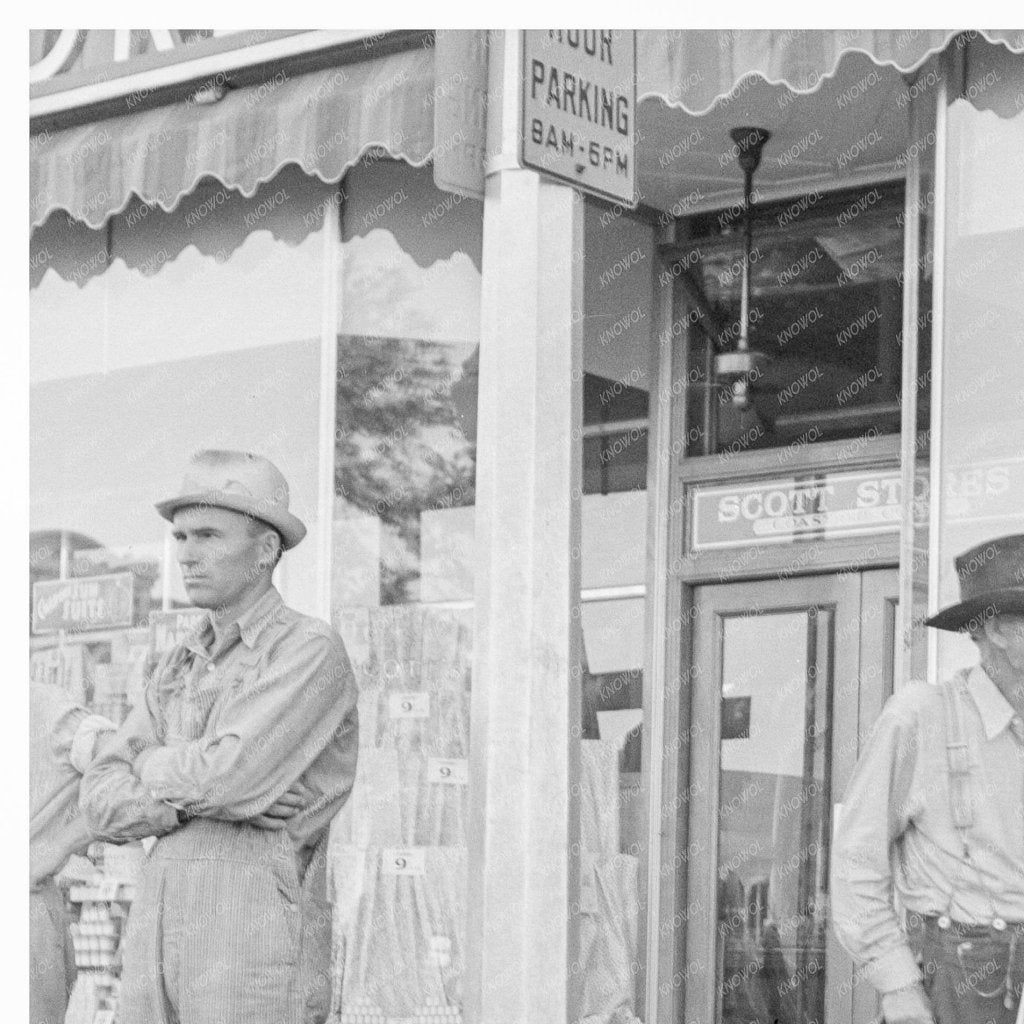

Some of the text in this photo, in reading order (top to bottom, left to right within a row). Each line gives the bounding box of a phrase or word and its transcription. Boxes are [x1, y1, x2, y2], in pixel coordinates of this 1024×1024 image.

[531, 58, 628, 136] PARKING
[717, 485, 835, 522] SCOTT
[401, 701, 413, 713] 9
[439, 766, 451, 778] 9
[395, 857, 407, 870] 9
